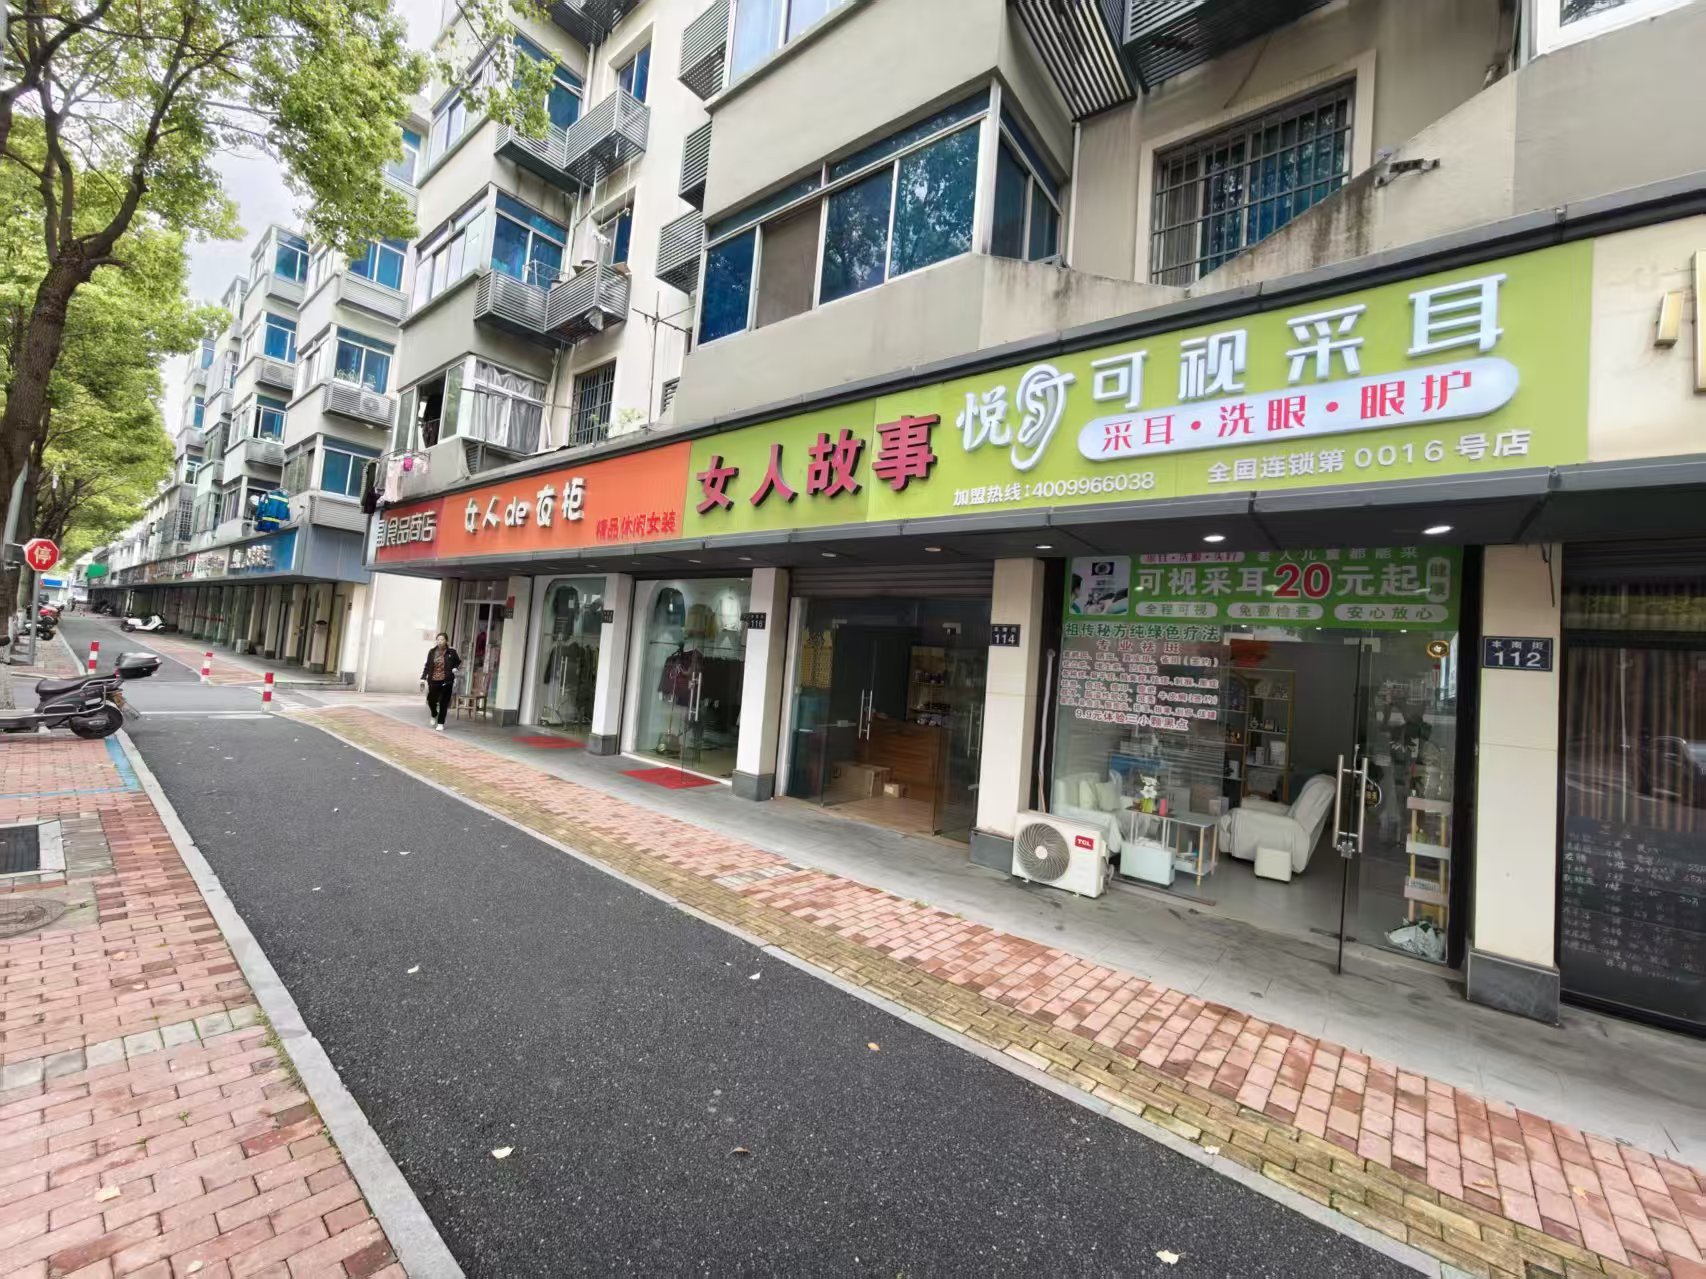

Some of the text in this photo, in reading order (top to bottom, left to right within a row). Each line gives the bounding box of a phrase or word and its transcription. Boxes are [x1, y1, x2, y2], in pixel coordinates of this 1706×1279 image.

[697, 414, 941, 514] 女人故事
[34, 546, 52, 564] 停
[1347, 606, 1433, 621] 安心放心
[995, 634, 1016, 644] 114
[1066, 623, 1219, 641] 祖传秘方纯绿色疗法
[1493, 651, 1541, 667] 112
[1077, 838, 1092, 847] TCL
